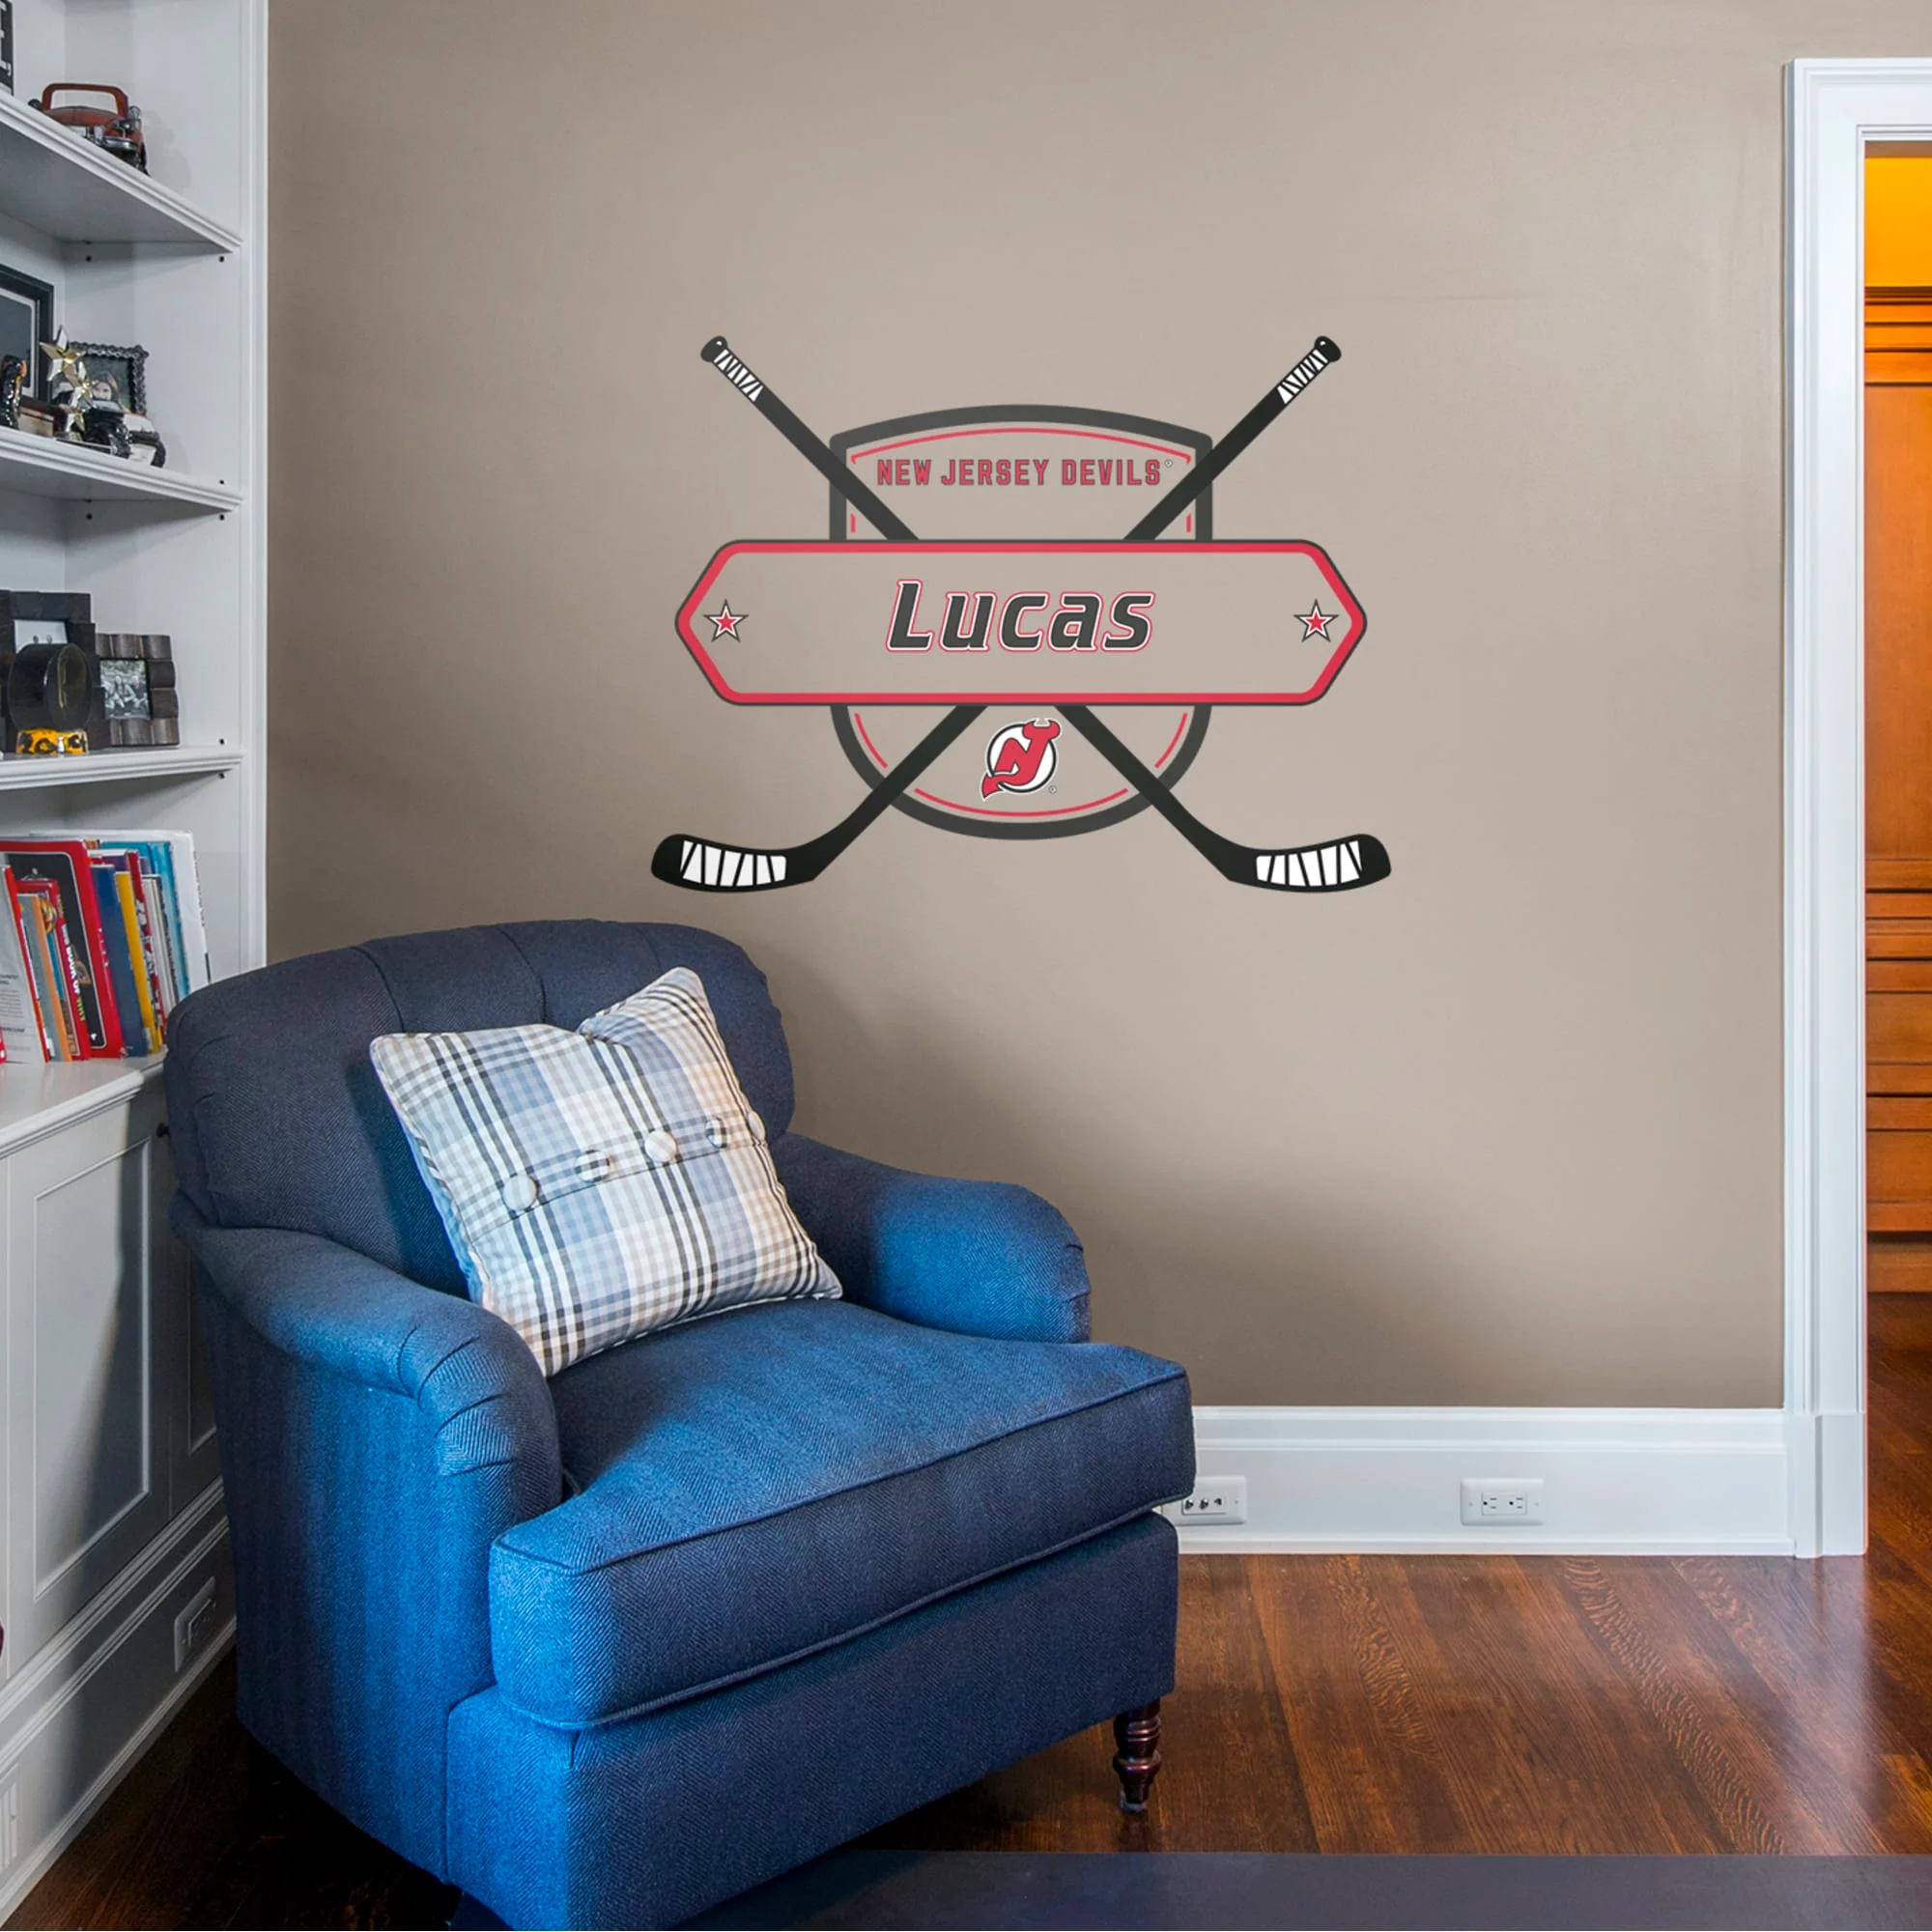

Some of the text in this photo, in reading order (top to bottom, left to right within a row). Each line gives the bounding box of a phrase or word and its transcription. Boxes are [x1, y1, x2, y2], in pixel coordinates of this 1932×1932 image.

[877, 459, 1160, 486] NEW JERSEY DEVILS
[886, 579, 1156, 653] Lucas
